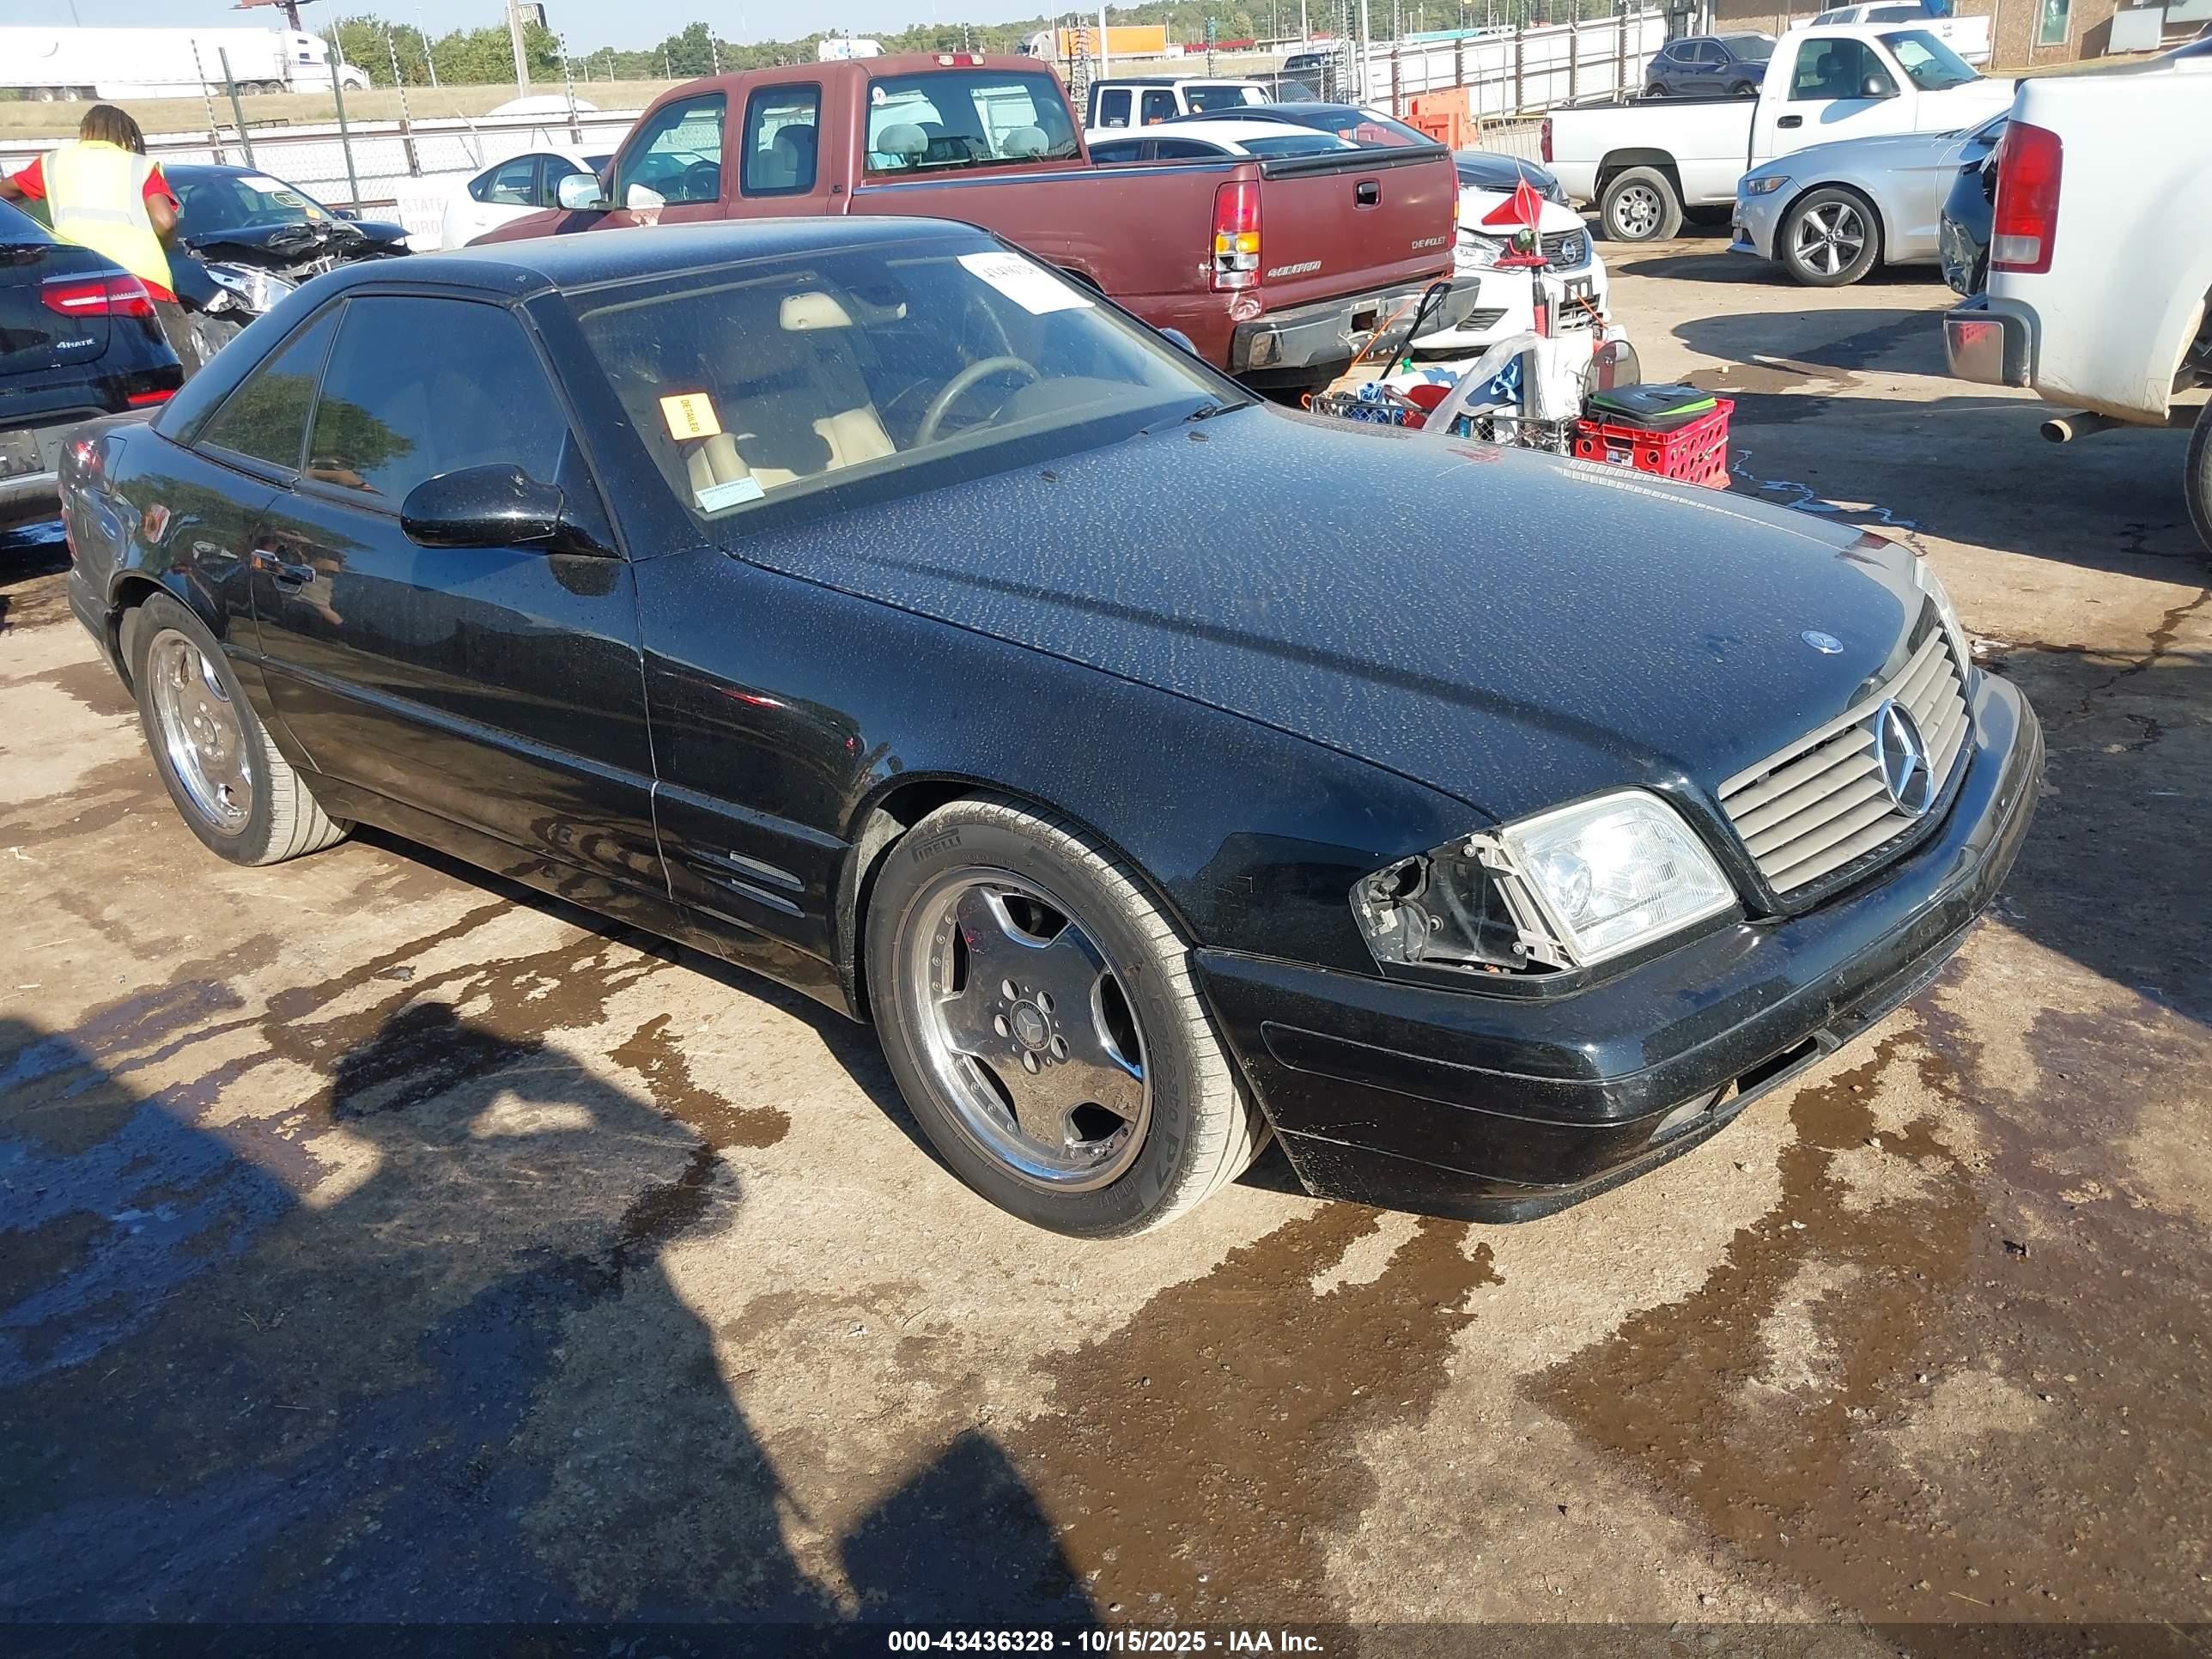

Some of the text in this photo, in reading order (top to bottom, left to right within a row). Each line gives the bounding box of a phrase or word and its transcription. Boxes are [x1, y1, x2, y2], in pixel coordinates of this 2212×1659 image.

[402, 198, 444, 213] STATE
[410, 220, 443, 235] DRO
[1411, 235, 1446, 250] CHEVROLET
[56, 338, 96, 349] 4MATIC
[680, 399, 701, 433] DETAILED
[910, 827, 963, 864] PIRELLI
[1152, 1130, 1182, 1192] P7
